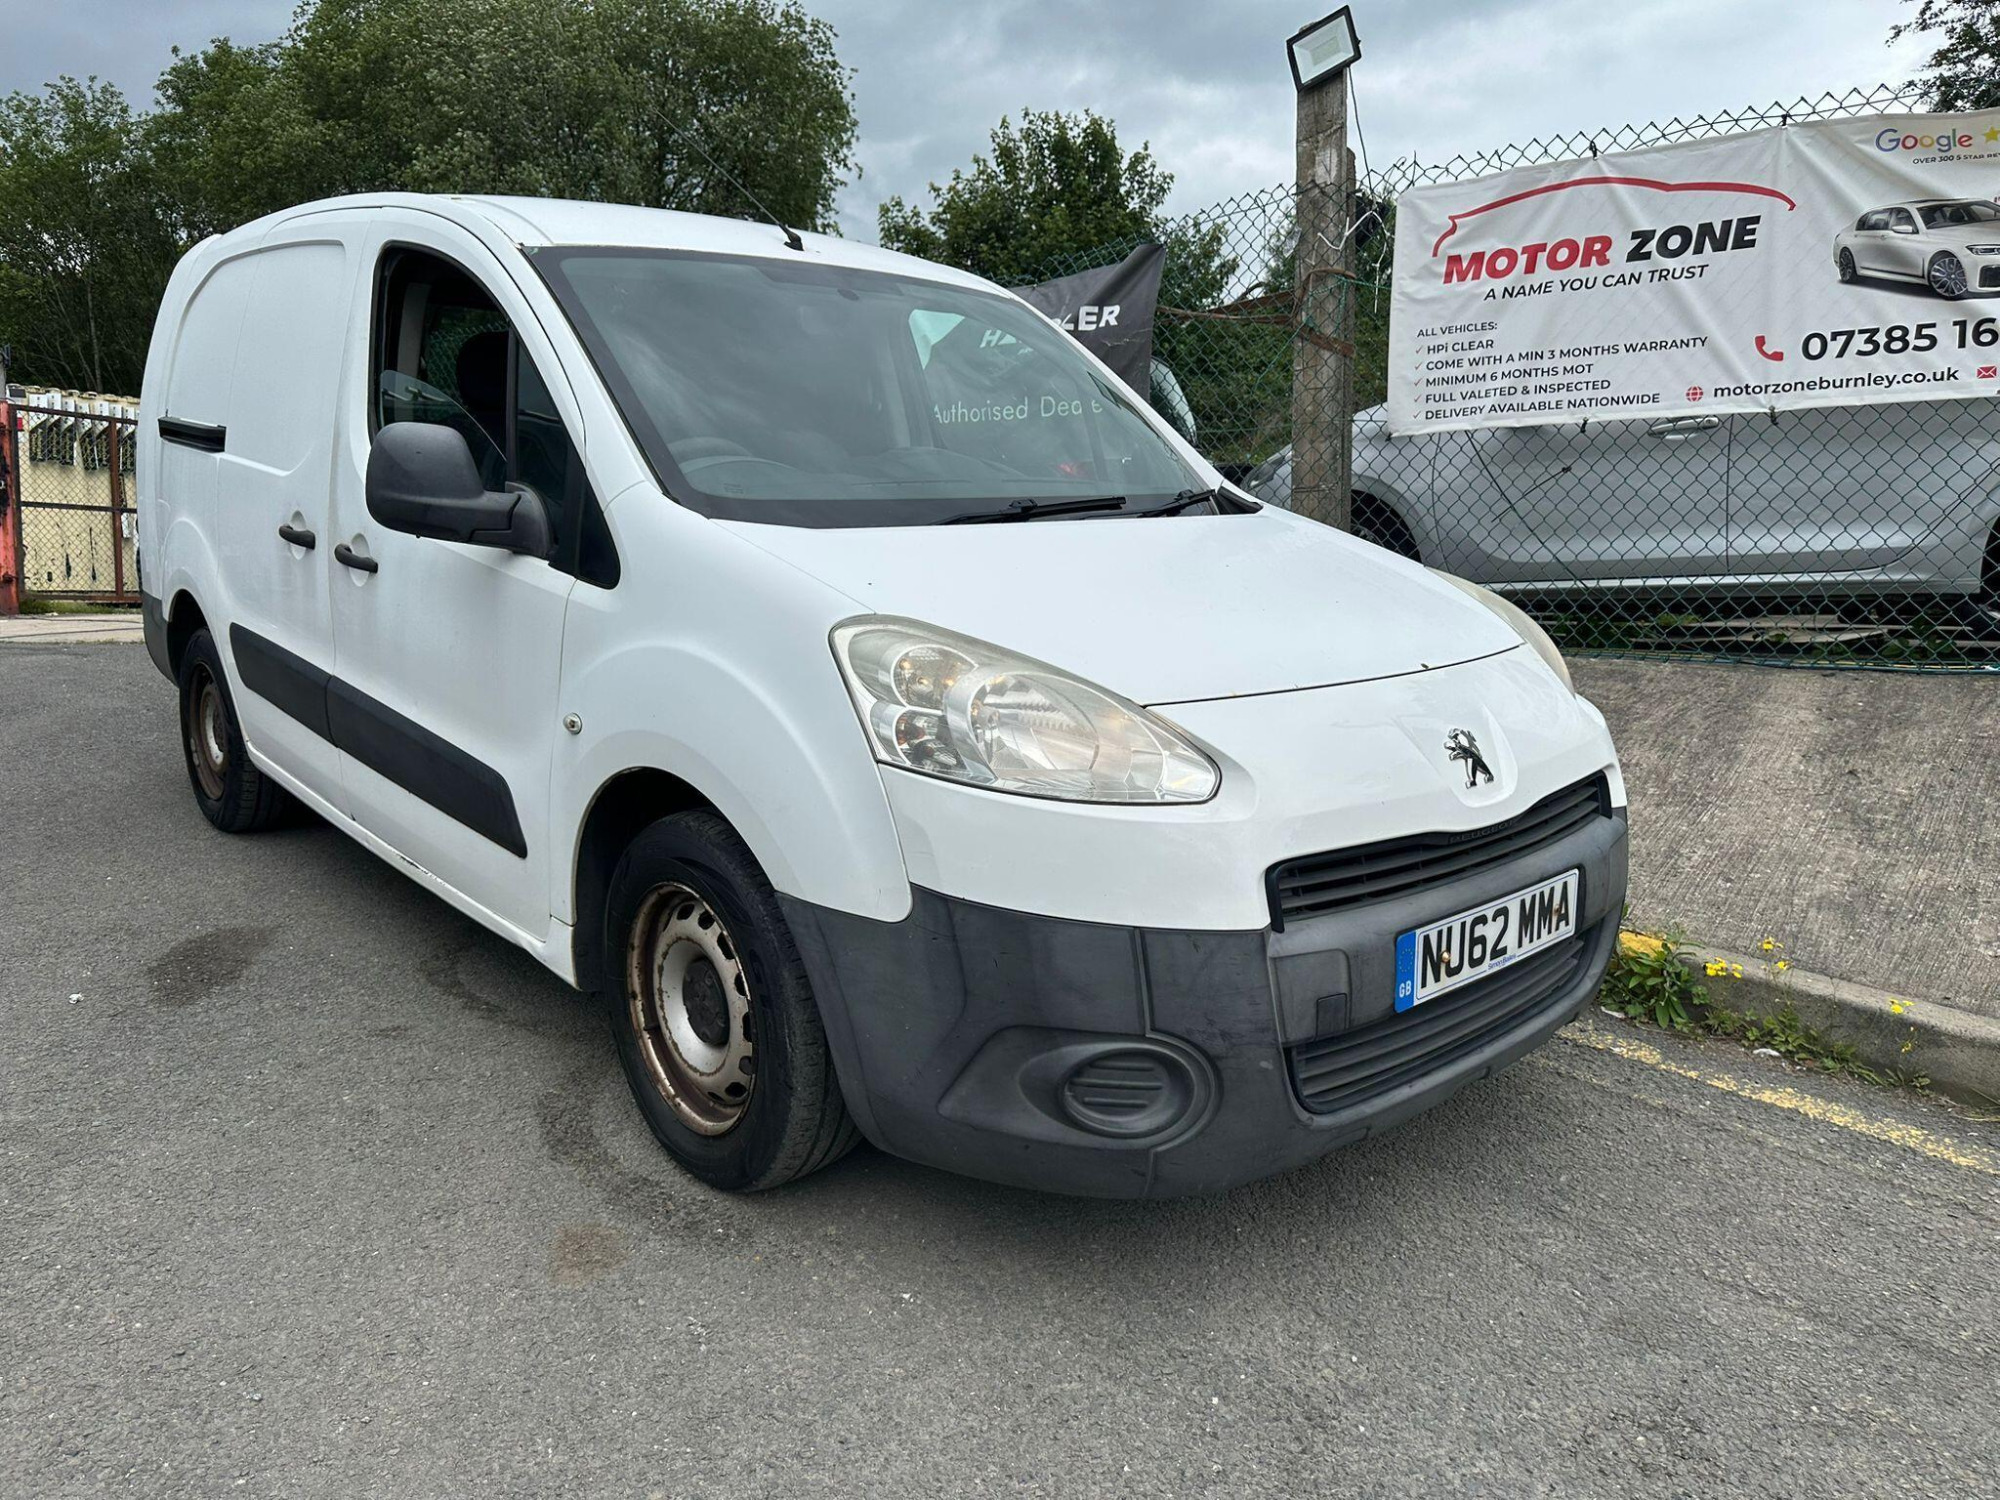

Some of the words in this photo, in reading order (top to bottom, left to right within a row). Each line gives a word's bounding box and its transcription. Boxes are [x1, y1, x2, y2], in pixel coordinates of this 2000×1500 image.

[1875, 128, 1973, 153] Google
[1912, 156, 1937, 165] OVER
[1939, 155, 1954, 163] 300
[1443, 235, 1613, 285] MOTOR
[1625, 214, 1762, 263] ZONE
[1484, 288, 1497, 301] A
[1502, 280, 1554, 299] NAME
[1559, 276, 1598, 293] YOU
[1602, 271, 1642, 288] CAN
[1648, 264, 1709, 284] TRUST
[1416, 327, 1438, 338] ALL
[1440, 321, 1498, 335] VEHICLES:
[1801, 321, 1938, 362] 07385
[1426, 358, 1464, 371] COME
[1468, 355, 1503, 367] WITH
[1505, 353, 1515, 364] A
[1518, 350, 1544, 362] MIN
[1547, 349, 1555, 360] 3
[1559, 344, 1620, 359] MONTHS
[1623, 336, 1708, 353] WARRANTY
[1427, 342, 1449, 355] HPi
[1452, 339, 1495, 353] CLEAR
[1425, 372, 1487, 387] MINIMUM
[1490, 371, 1498, 382] 6
[1500, 366, 1559, 381] MONTHS
[1563, 363, 1594, 376] MOT
[1713, 366, 1960, 398] motorzoneburnley.co.uk
[1425, 392, 1456, 404] FULL
[1460, 385, 1518, 401] VALETED
[1521, 385, 1530, 396] &
[1533, 379, 1611, 395] INSPECTED
[934, 396, 1029, 424] Authorised
[1425, 405, 1486, 420] DELIVERY
[1488, 399, 1563, 414] AVAILABLE
[1567, 392, 1660, 410] NATIONWIDE
[1420, 905, 1510, 989] NU62
[1517, 880, 1570, 949] MMA
[1399, 980, 1411, 999] GB
